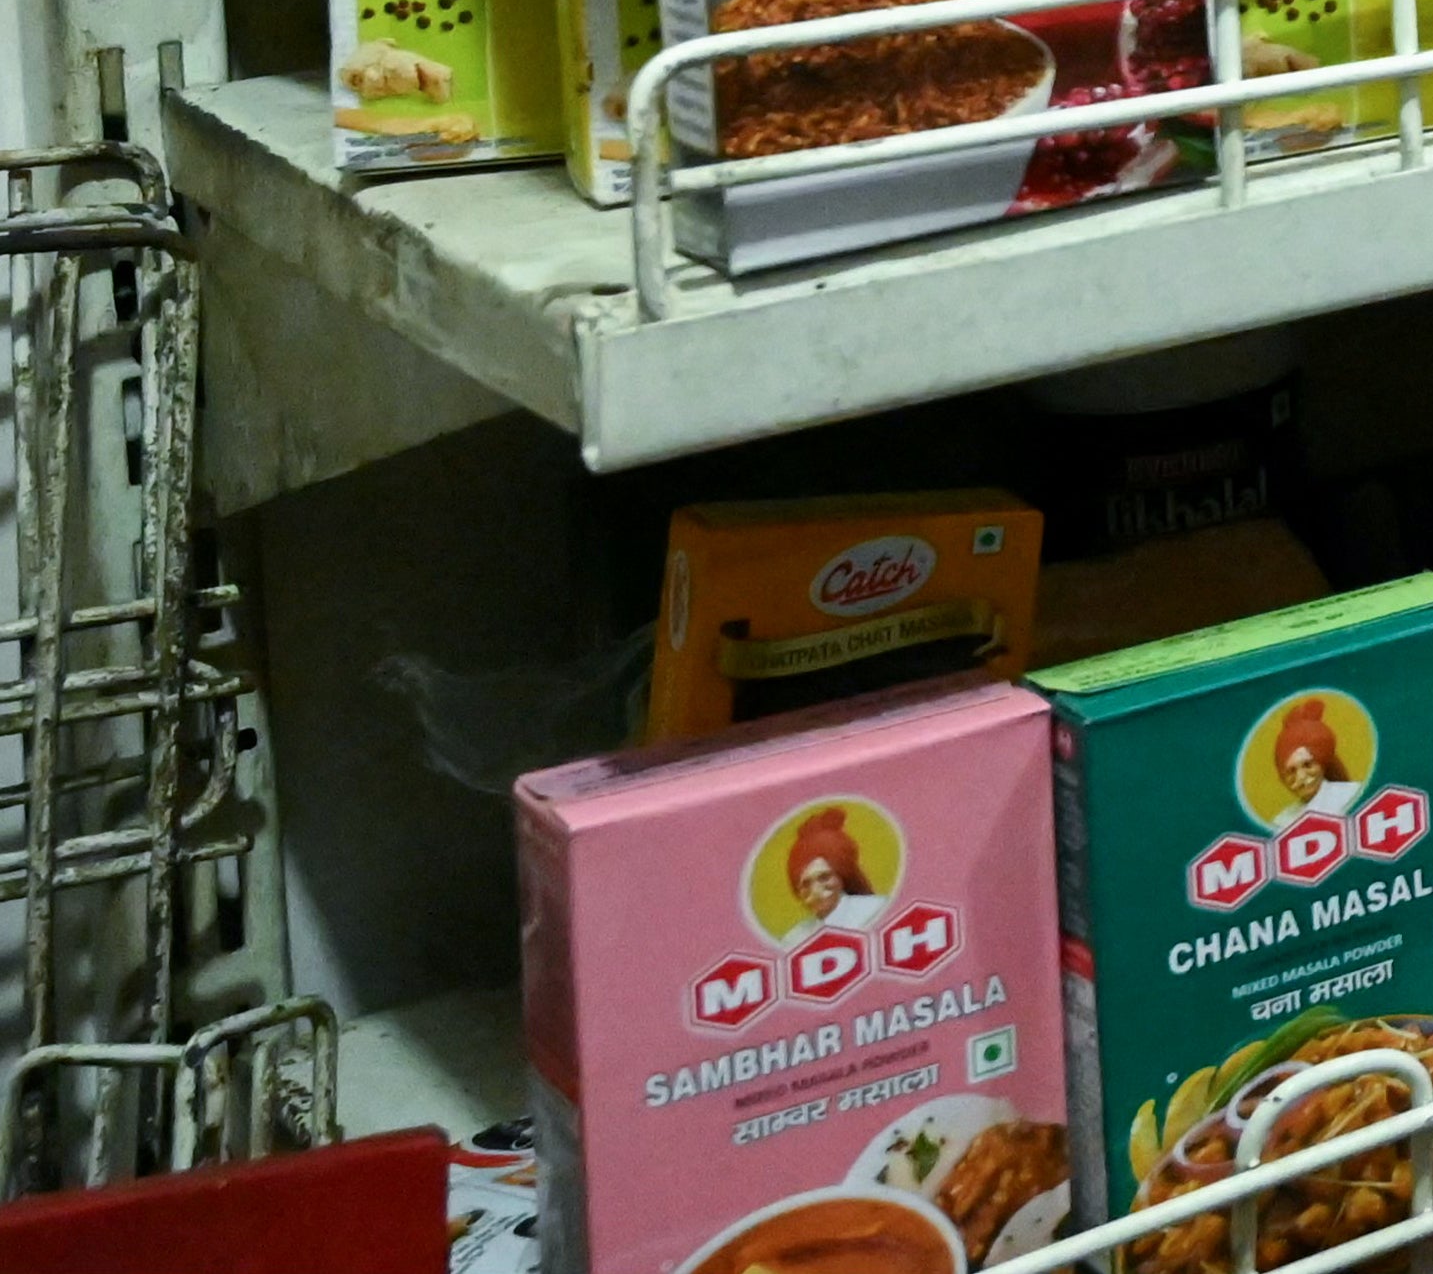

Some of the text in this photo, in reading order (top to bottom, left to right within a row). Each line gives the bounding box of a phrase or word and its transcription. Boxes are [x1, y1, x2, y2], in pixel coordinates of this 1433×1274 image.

[817, 547, 922, 606] Catch
[1168, 909, 1300, 975] CHANA
[1249, 957, 1396, 1022] चना मसाला
[643, 973, 1008, 1108] SAMBHAR MASALA
